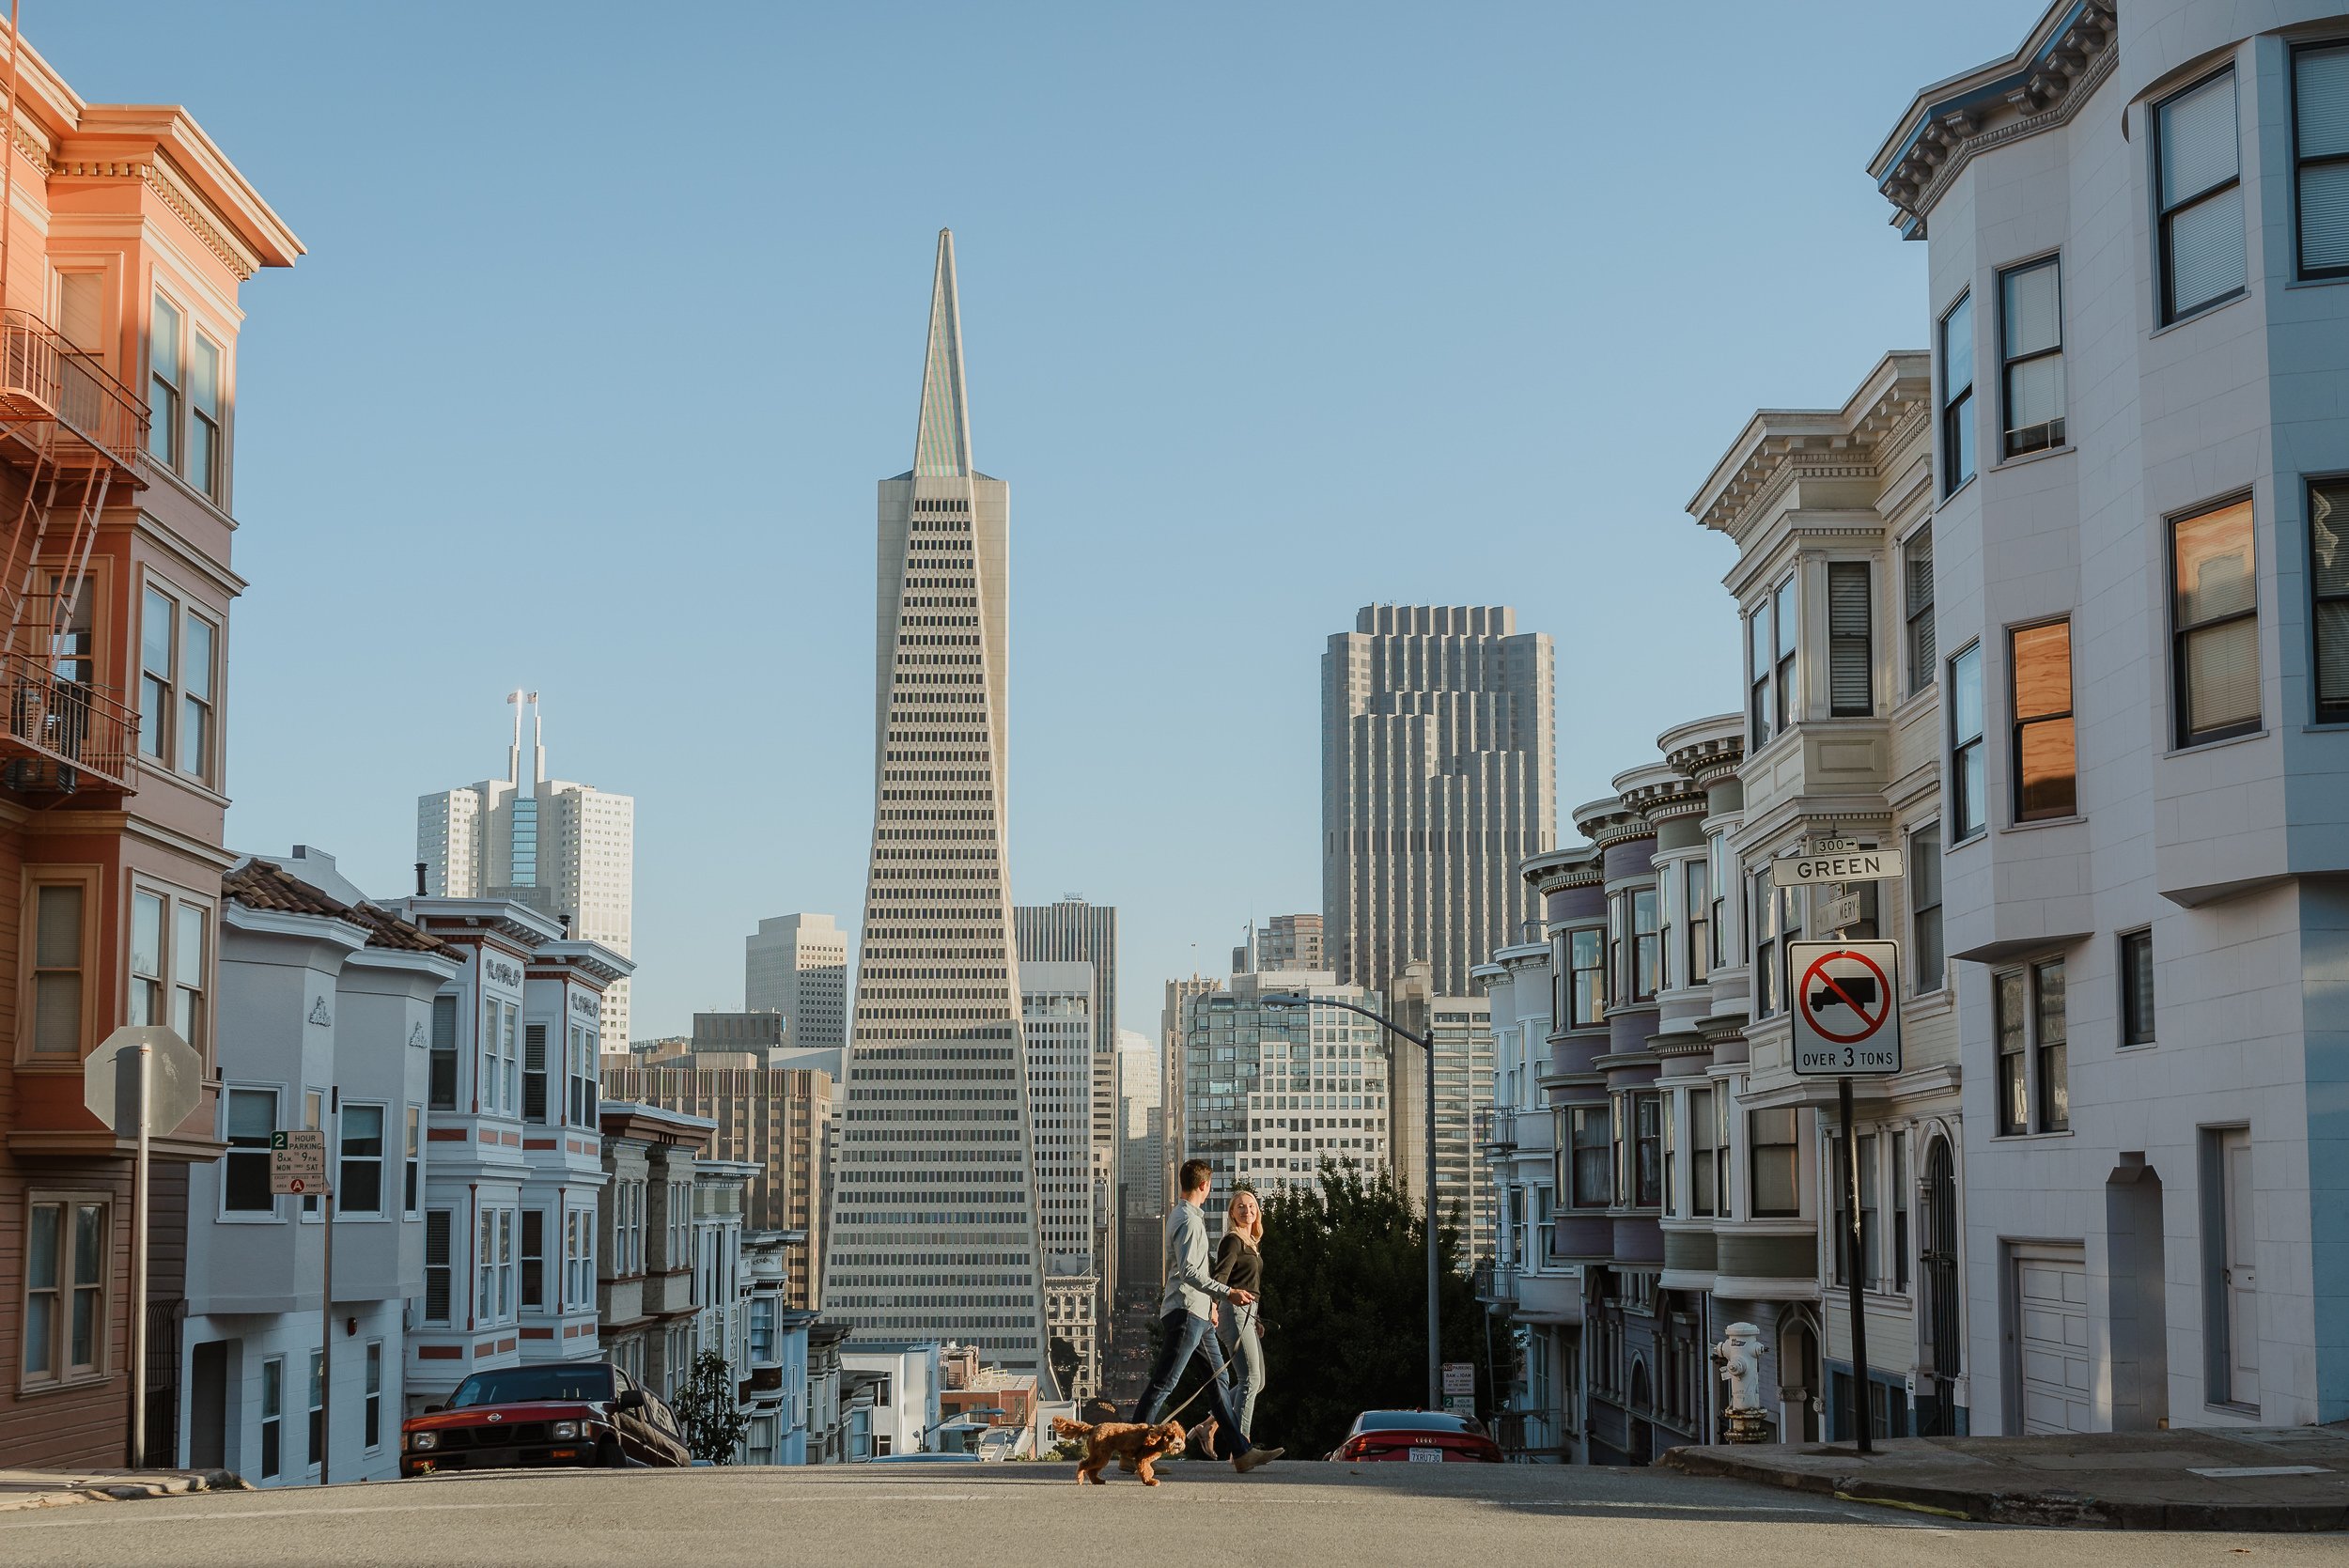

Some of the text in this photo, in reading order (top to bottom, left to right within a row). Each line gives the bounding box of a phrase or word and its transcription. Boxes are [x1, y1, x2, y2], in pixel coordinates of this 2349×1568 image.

[1819, 840, 1843, 851] 300
[1797, 856, 1880, 878] GREEN
[1803, 1047, 1892, 1067] OVER 3 TONS
[274, 1134, 284, 1147] 2
[293, 1180, 302, 1189] A
[1446, 1398, 1452, 1406] 2
[1411, 1453, 1440, 1463] 7XRU730
